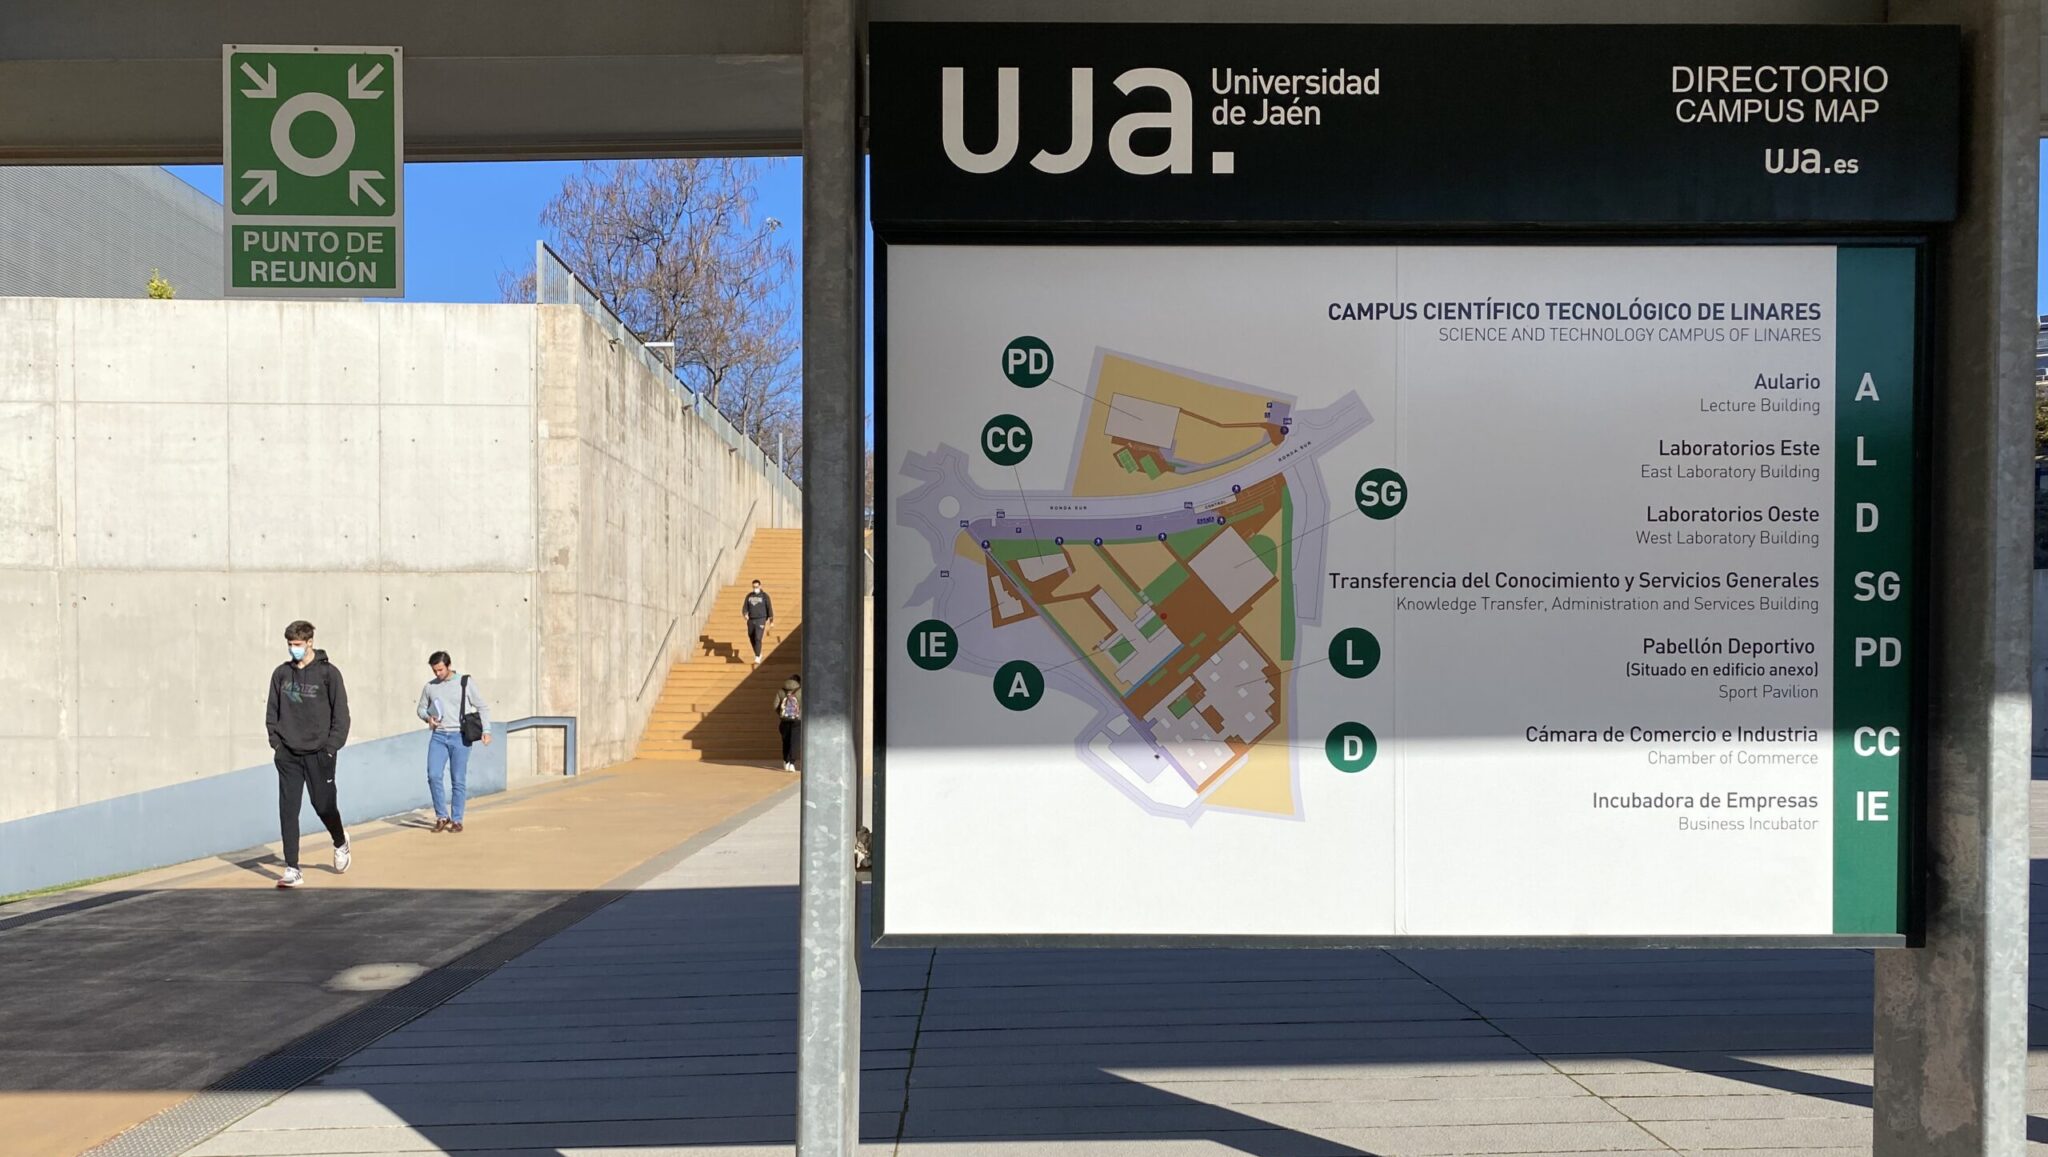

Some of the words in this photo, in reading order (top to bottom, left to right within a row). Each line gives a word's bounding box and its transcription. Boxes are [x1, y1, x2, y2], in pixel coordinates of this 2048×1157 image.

[1212, 67, 1380, 95] Universidad
[1672, 65, 1889, 93] DIRECTORIO
[1211, 98, 1247, 126] de
[1252, 96, 1321, 126] Jaén
[1675, 98, 1805, 123] CAMPUS
[1815, 98, 1880, 123] MAP
[243, 230, 340, 254] PUNTO
[346, 231, 384, 254] DE
[250, 255, 377, 283] REUNIÓN
[1328, 302, 1418, 321] CAMPUS
[1423, 296, 1540, 321] CIENTÍFICO
[1544, 296, 1692, 321] TECNOLÓGICO
[1697, 302, 1725, 321] DE
[1731, 302, 1822, 321] LINARES
[1438, 327, 1508, 342] SCIENCE
[1510, 327, 1546, 342] AND
[1549, 327, 1655, 342] TECHNOLOGY
[1658, 327, 1725, 342] CAMPUS
[1728, 327, 1750, 342] OF
[1754, 327, 1822, 343] LINARES
[1008, 348, 1048, 375] PD
[1753, 372, 1821, 390] Aulario
[1854, 372, 1880, 402] A
[1700, 398, 1757, 413] Lecture
[1760, 397, 1821, 417] Building
[986, 426, 1026, 453] CC
[1659, 439, 1776, 457] Laboratorios
[1780, 439, 1821, 456] Este
[1856, 435, 1877, 466] L
[1641, 463, 1673, 479] East
[1677, 464, 1757, 482] Laboratory
[1760, 464, 1820, 483] Building
[1360, 480, 1402, 507] SG
[1647, 505, 1764, 523] Laboratorios
[1767, 505, 1820, 523] Oeste
[1856, 502, 1879, 533] D
[1635, 530, 1673, 545] West
[1676, 530, 1757, 549] Laboratory
[1759, 530, 1820, 549] Building
[1328, 571, 1457, 589] Transferencia
[1461, 571, 1491, 589] del
[1495, 571, 1620, 589] Conocimiento
[1624, 575, 1635, 593] y
[1639, 571, 1721, 589] Servicios
[1726, 571, 1820, 589] Generales
[1853, 570, 1901, 602] SG
[1396, 596, 1477, 615] Knowledge
[1480, 596, 1548, 613] Transfer,
[1551, 596, 1659, 611] Administration
[1662, 596, 1690, 611] and
[1693, 596, 1756, 611] Services
[1759, 596, 1819, 615] Building
[919, 631, 947, 658] IE
[1346, 639, 1364, 666] L
[1643, 636, 1723, 655] Pabellón
[1728, 637, 1815, 659] Deportivo
[1855, 636, 1902, 668] PD
[1626, 661, 1687, 678] (Situado
[1690, 665, 1709, 677] en
[1712, 662, 1766, 677] edificio
[1768, 660, 1819, 678] anexo)
[1007, 671, 1030, 698] A
[1718, 684, 1758, 703] Sport
[1762, 684, 1819, 699] Pavilion
[1525, 724, 1598, 743] Cámara
[1602, 725, 1625, 743] de
[1629, 725, 1717, 743] Comercio
[1721, 729, 1733, 743] e
[1737, 725, 1818, 743] Industria
[1853, 726, 1901, 757] CC
[1343, 735, 1364, 762] D
[1647, 749, 1717, 765] Chamber
[1719, 750, 1734, 765] of
[1737, 750, 1819, 765] Commerce
[1593, 791, 1694, 809] Incubadora
[1699, 791, 1721, 809] de
[1727, 791, 1818, 813] Empresas
[1856, 790, 1889, 822] IE
[1678, 816, 1745, 831] Business
[1749, 816, 1820, 831] Incubator
